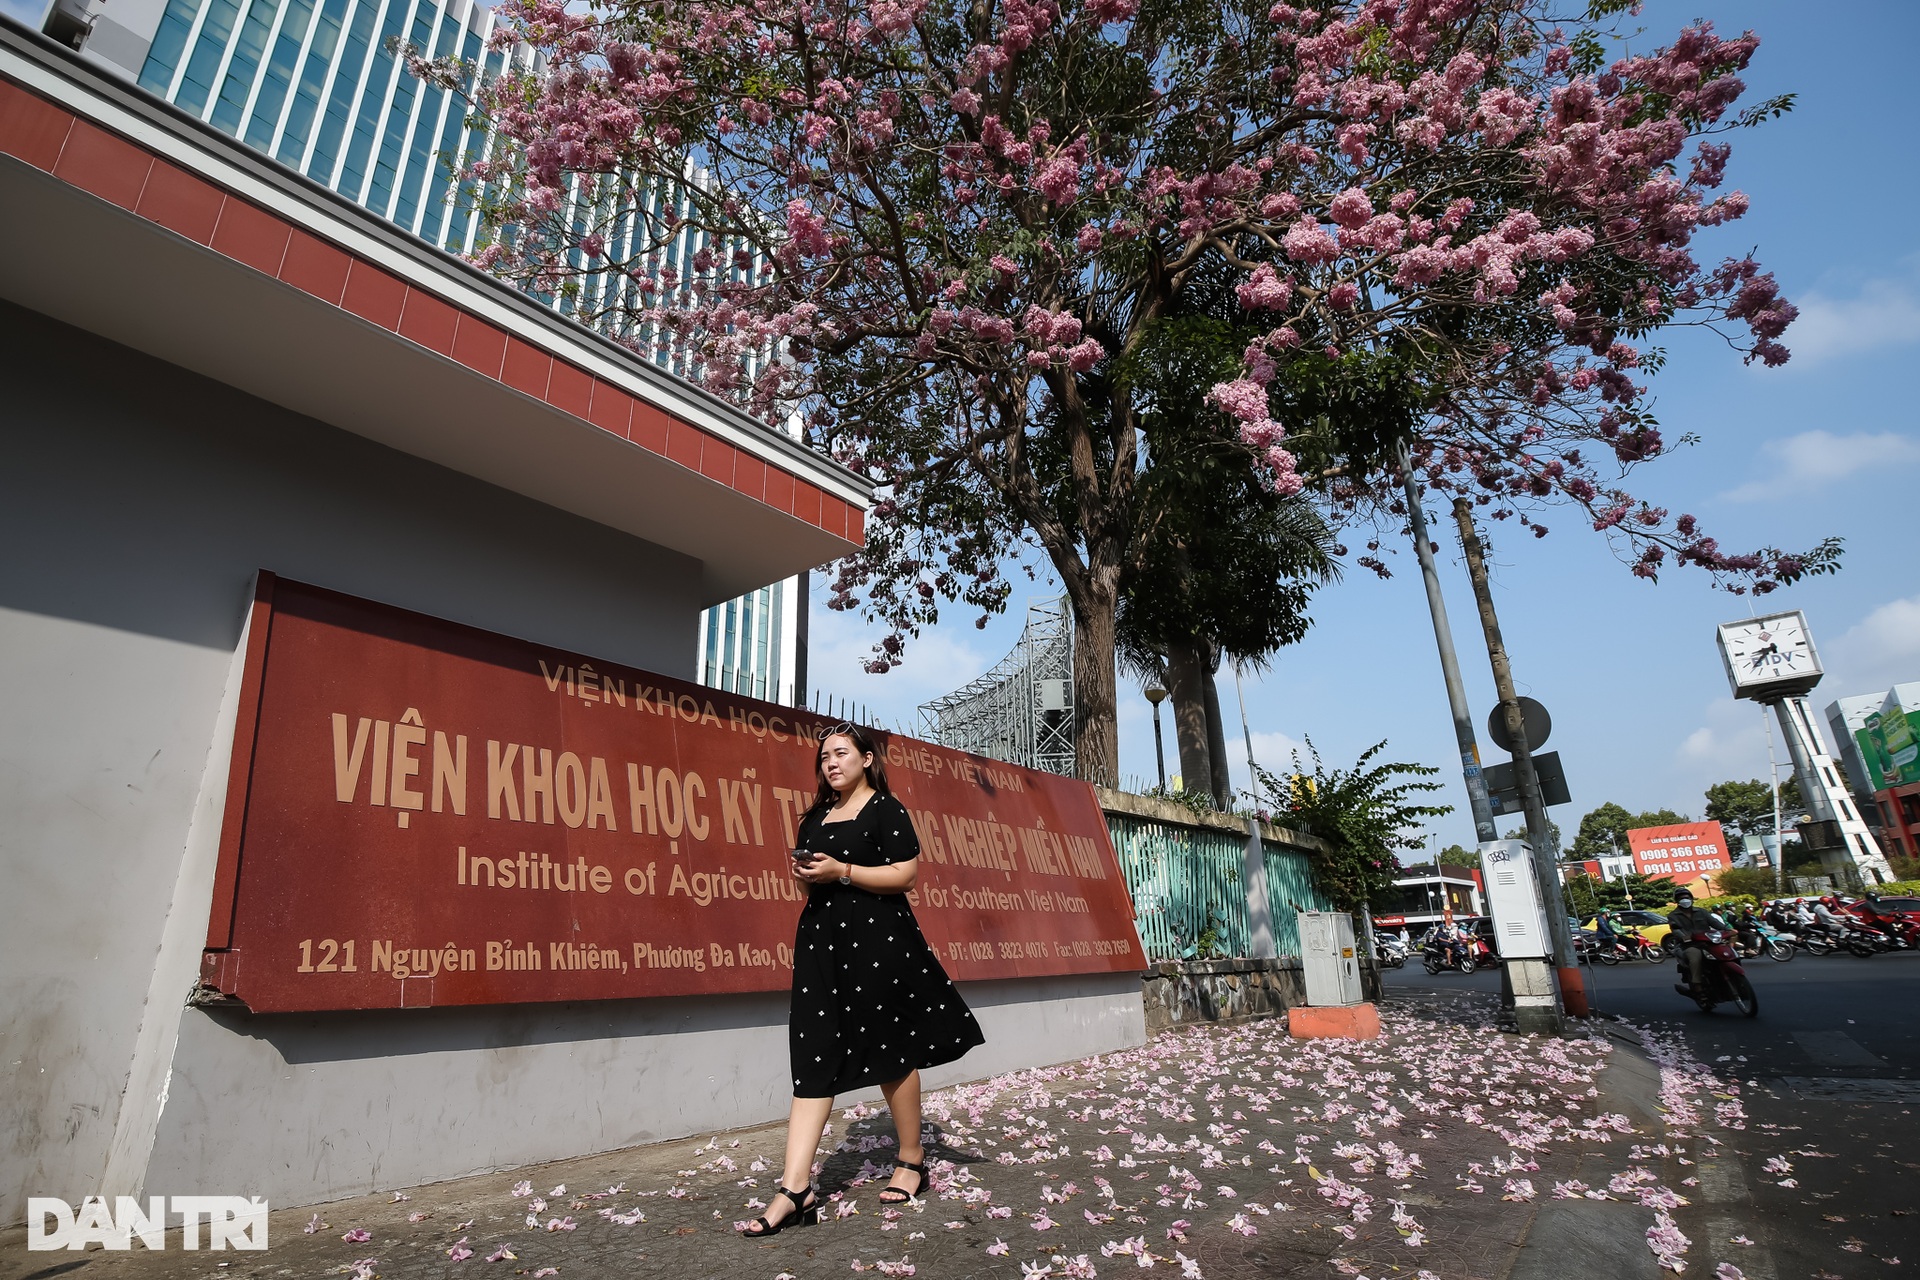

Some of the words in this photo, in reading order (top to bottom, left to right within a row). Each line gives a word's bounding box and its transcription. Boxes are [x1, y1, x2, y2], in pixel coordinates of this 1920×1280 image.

[538, 660, 626, 707] VIỆN
[635, 682, 722, 729] KHOA
[728, 706, 788, 743] HỌC
[795, 721, 824, 748] NÔ
[946, 758, 983, 787] VIỆT
[985, 767, 1024, 793] NAM
[332, 707, 467, 828] VIỆN
[487, 739, 617, 831] KHOA
[627, 762, 710, 854] HỌC
[718, 767, 765, 846] KỸ
[942, 811, 1018, 881] NGHIỆP
[1017, 815, 1071, 877] MIỀN
[1064, 833, 1107, 880] NAM
[1640, 848, 1668, 861] 0908
[1671, 846, 1693, 858] 366
[1694, 844, 1718, 856] 685
[1643, 862, 1672, 875] 0914
[1673, 860, 1696, 873] 531
[1698, 858, 1722, 871] 383
[457, 846, 613, 894] Institute
[624, 861, 656, 895] of
[923, 881, 949, 908] for
[950, 883, 1025, 911] Southern
[1023, 888, 1056, 912] Viet
[1054, 891, 1090, 913] Nam
[297, 938, 357, 973] 121
[486, 939, 541, 971] Bỉnh
[550, 942, 628, 975] Khiêm,
[709, 942, 735, 968] Đa
[738, 942, 776, 971] Kao,
[998, 941, 1025, 960] 3823
[1025, 941, 1049, 958] 4076
[1053, 941, 1073, 958] Fax:
[1093, 940, 1113, 956] 3829
